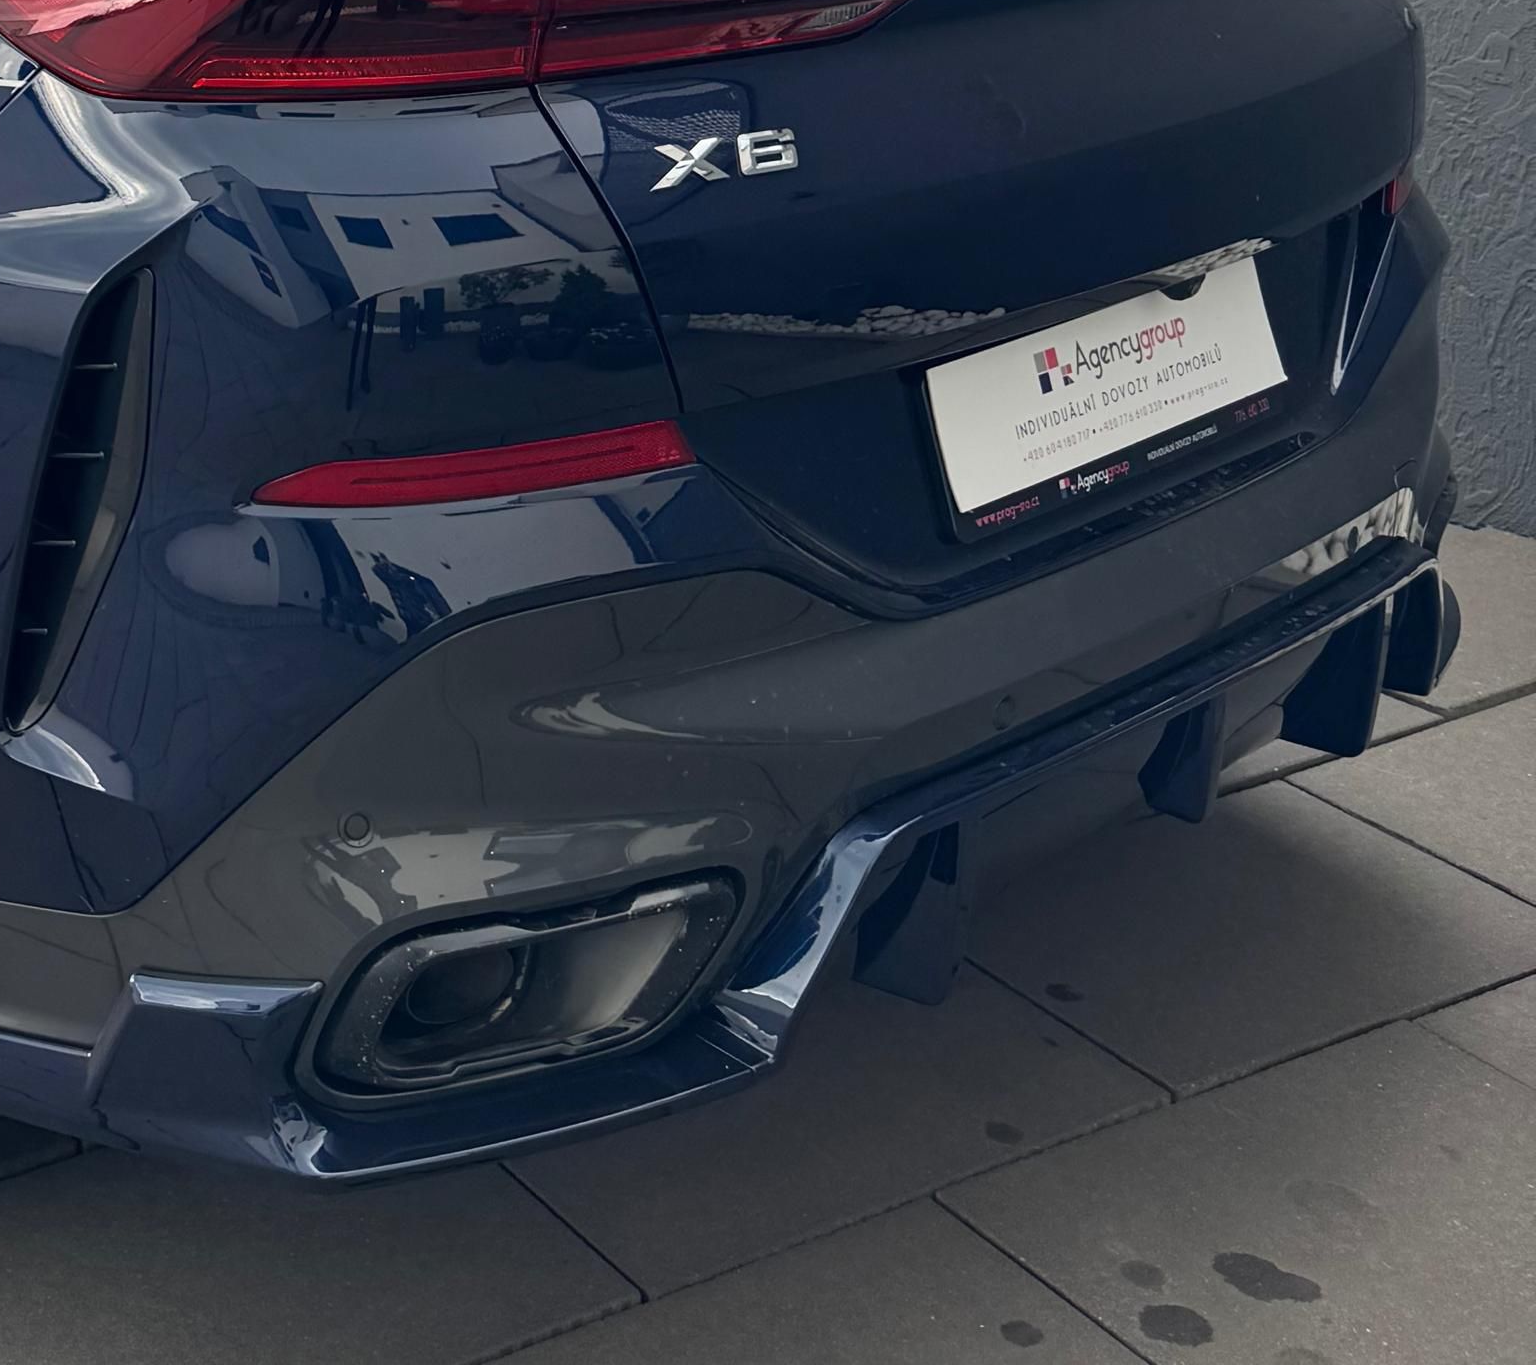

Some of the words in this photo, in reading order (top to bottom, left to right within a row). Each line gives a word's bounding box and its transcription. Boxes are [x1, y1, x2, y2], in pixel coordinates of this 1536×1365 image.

[649, 128, 799, 193] X6
[1075, 315, 1186, 379] Agencygroup
[1015, 393, 1097, 440] INDIVIDUÁLNÍ
[1102, 375, 1149, 407] DOVOZY
[1156, 342, 1222, 386] AUTOMOBILŮ
[1077, 460, 1130, 492] Agencygroup
